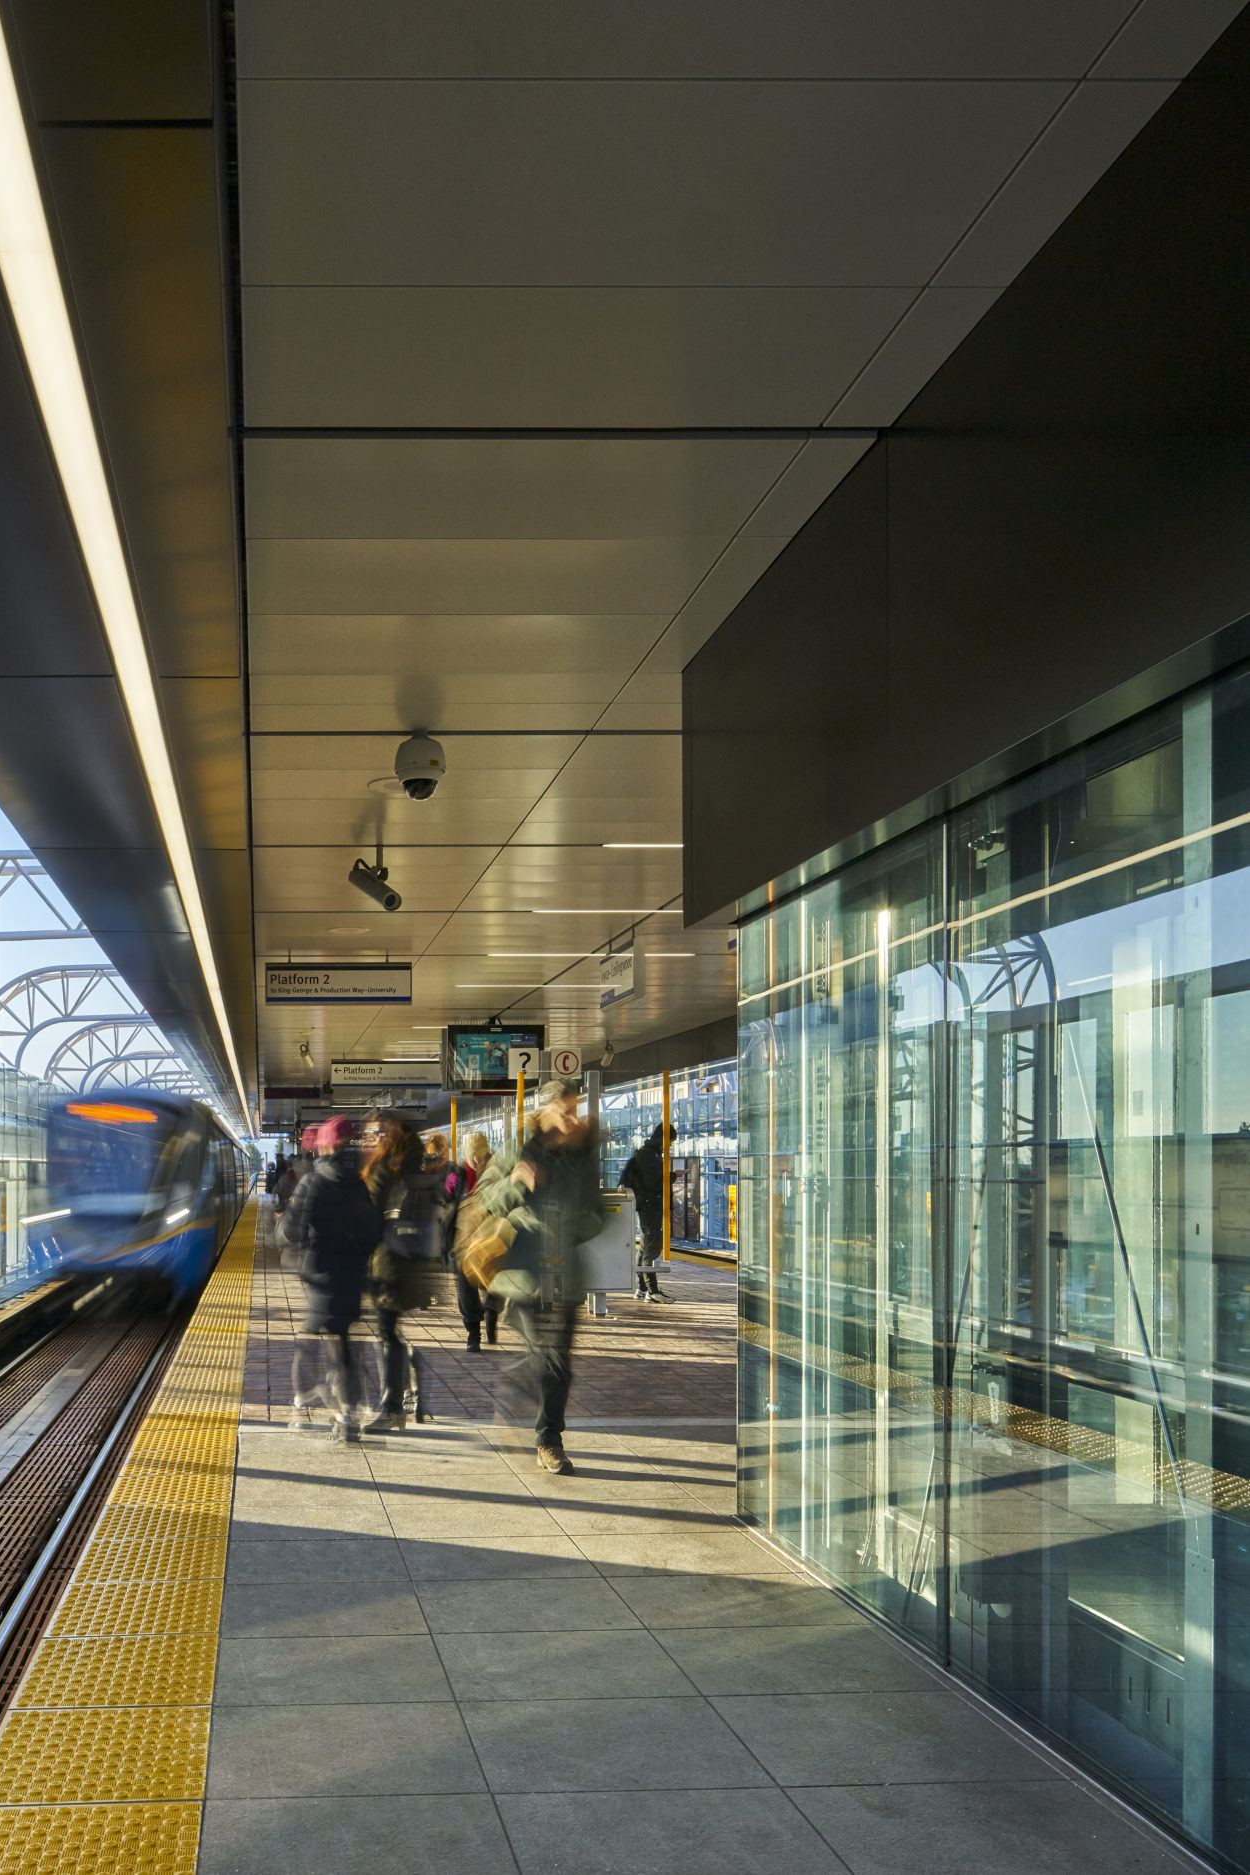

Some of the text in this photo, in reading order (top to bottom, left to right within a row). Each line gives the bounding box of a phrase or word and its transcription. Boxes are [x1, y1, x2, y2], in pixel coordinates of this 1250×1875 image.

[270, 974, 330, 985] Platform 2
[278, 987, 291, 995] King
[292, 987, 313, 995] George
[320, 986, 350, 994] Production
[343, 1066, 383, 1075] Platform 2
